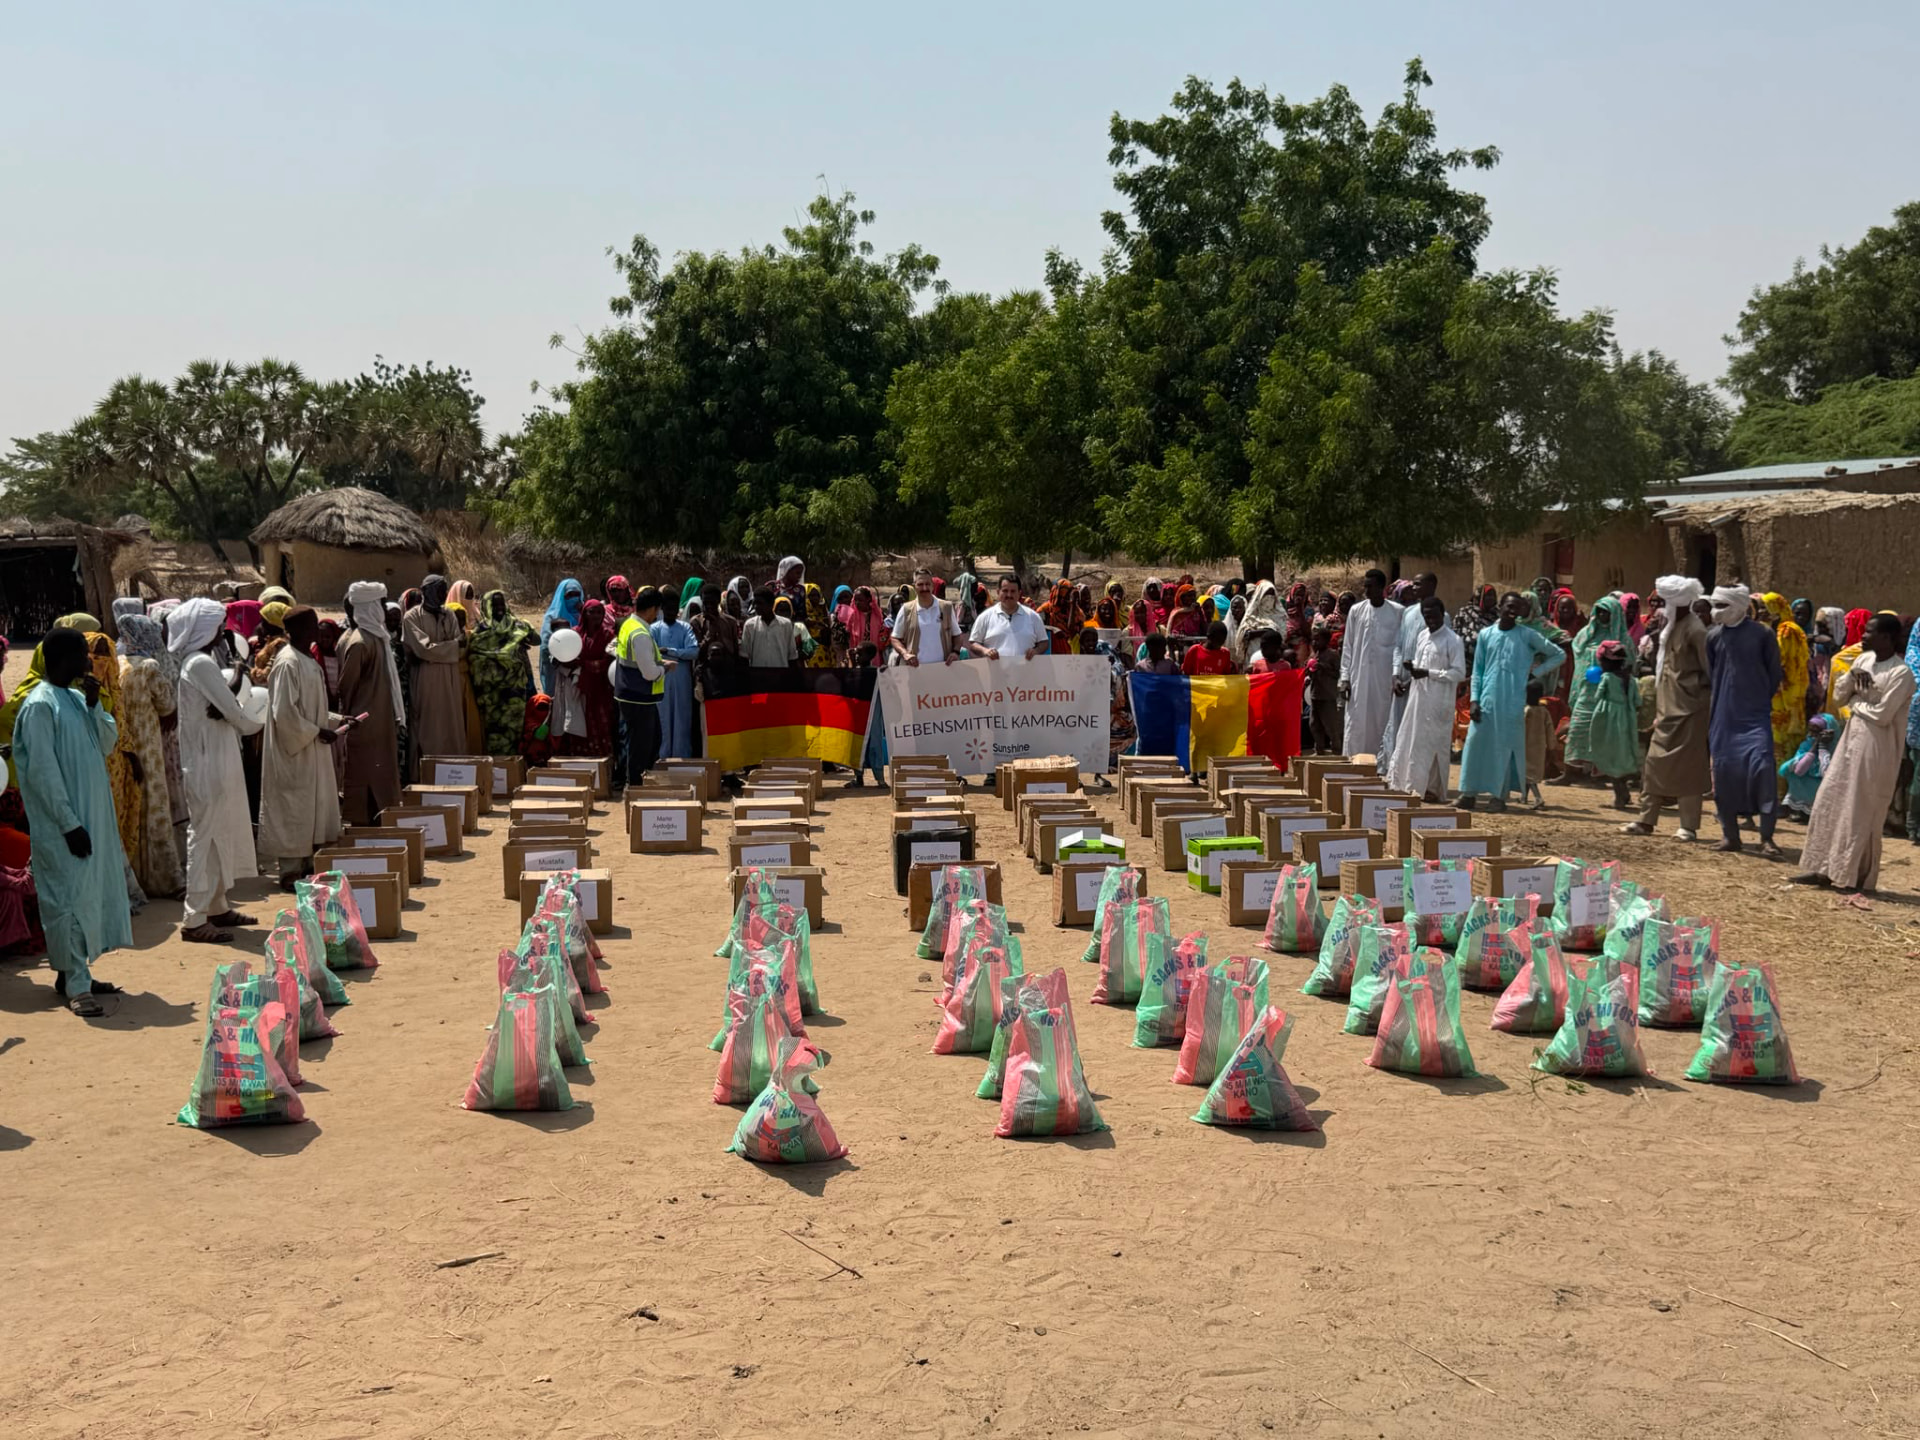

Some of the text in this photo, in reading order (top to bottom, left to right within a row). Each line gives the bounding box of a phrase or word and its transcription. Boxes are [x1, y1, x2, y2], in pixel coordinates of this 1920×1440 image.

[917, 685, 1075, 710] Kumanya Yardımı
[894, 714, 1099, 739] LEBENSMITTEL KAMPAGNE
[992, 743, 1030, 753] Sunshine
[1682, 940, 1692, 955] &
[227, 1028, 238, 1041] &
[225, 1087, 253, 1098] KANO
[1233, 1087, 1258, 1098] KANO
